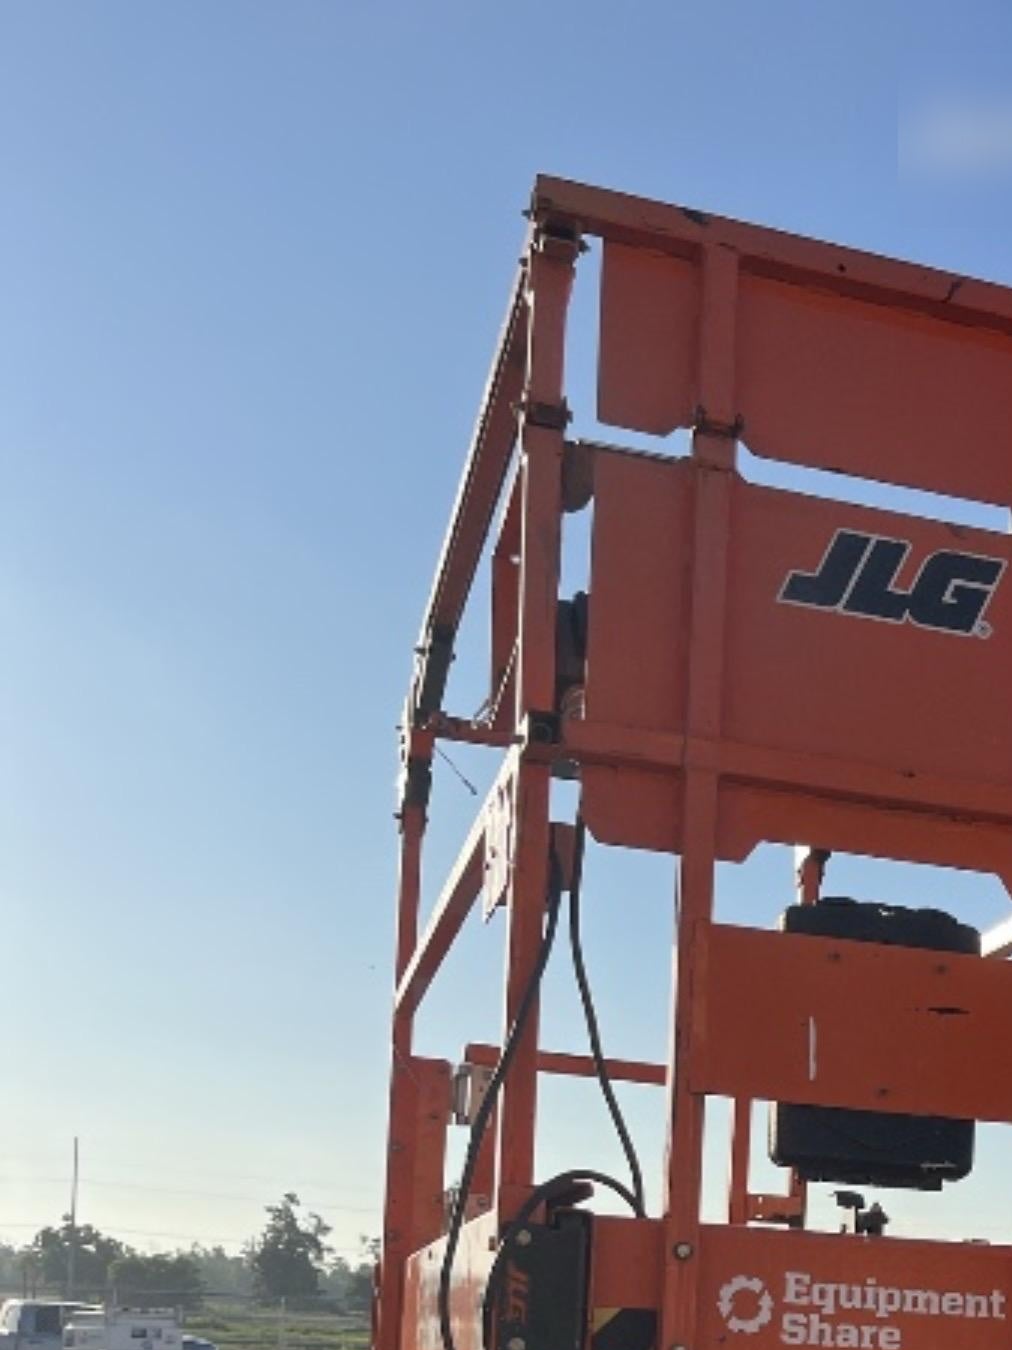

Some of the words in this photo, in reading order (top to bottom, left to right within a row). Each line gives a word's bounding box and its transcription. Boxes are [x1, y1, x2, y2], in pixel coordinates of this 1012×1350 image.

[777, 527, 1008, 638] JLG
[783, 1271, 1006, 1319] Equipment
[780, 1312, 901, 1350] Share
